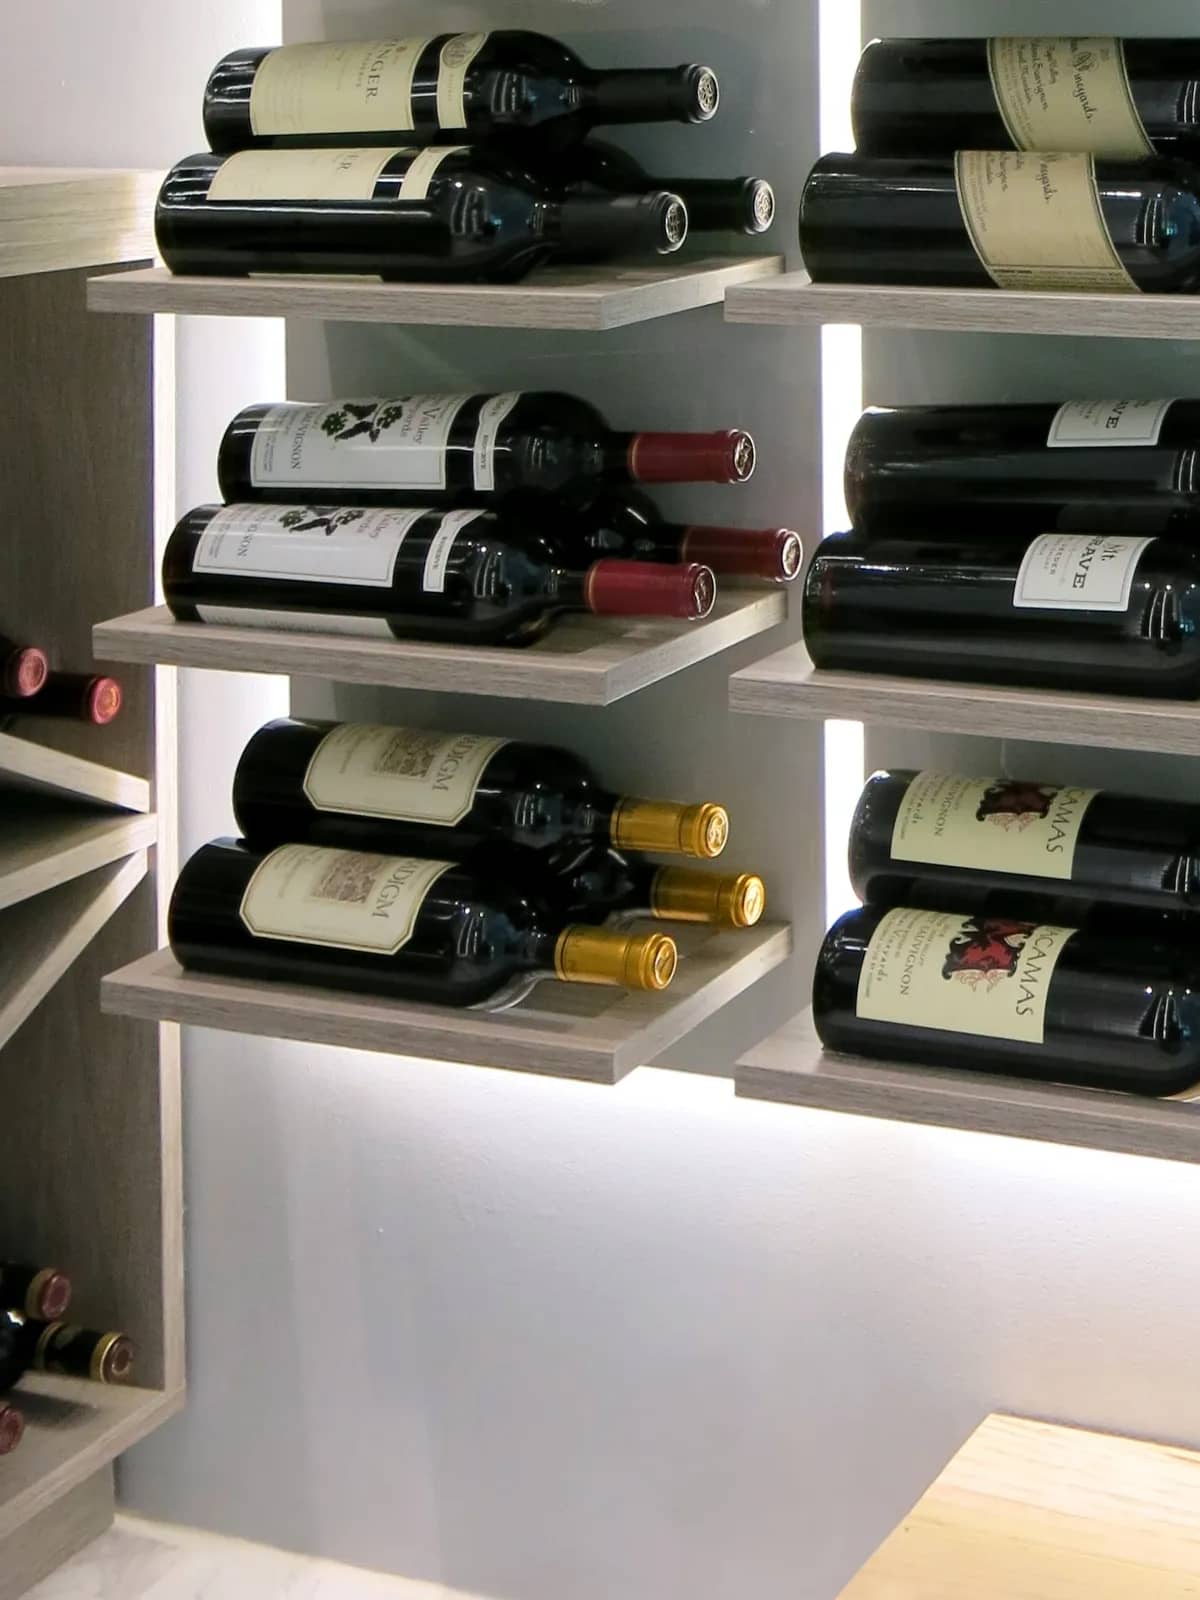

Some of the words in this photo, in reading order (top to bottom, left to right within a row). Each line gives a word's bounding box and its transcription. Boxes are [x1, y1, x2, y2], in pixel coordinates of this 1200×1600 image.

[366, 41, 397, 99] INGER
[413, 406, 442, 446] Valley
[1071, 536, 1105, 590] RAVE
[432, 734, 481, 792] ADIGM
[1045, 786, 1086, 854] CAMAS
